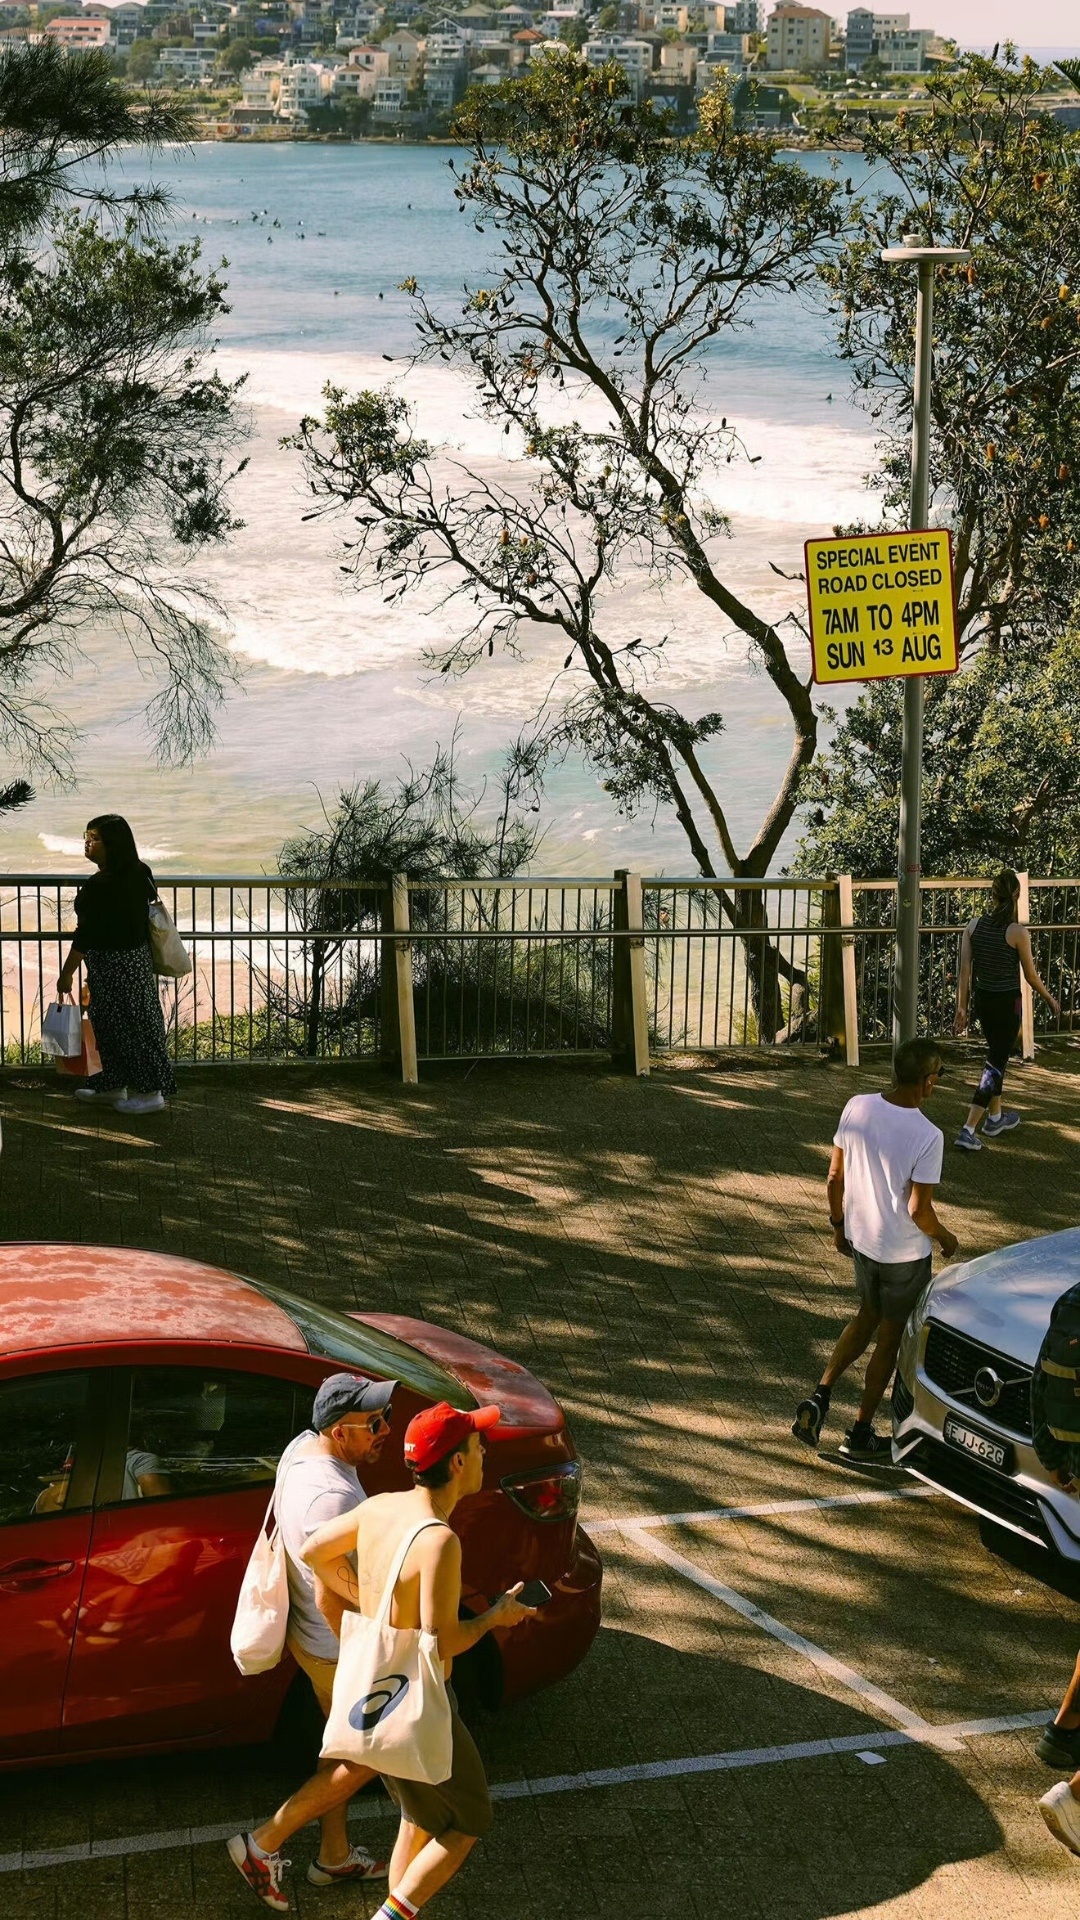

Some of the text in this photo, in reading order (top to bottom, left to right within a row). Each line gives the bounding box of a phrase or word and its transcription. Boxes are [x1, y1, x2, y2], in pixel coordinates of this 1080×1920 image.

[817, 542, 940, 570] SPECIAL EVENT
[818, 568, 942, 595] ROAD CLOSED
[822, 599, 939, 636] 7AM TO 4PM
[827, 633, 942, 670] SUN 13 AUG
